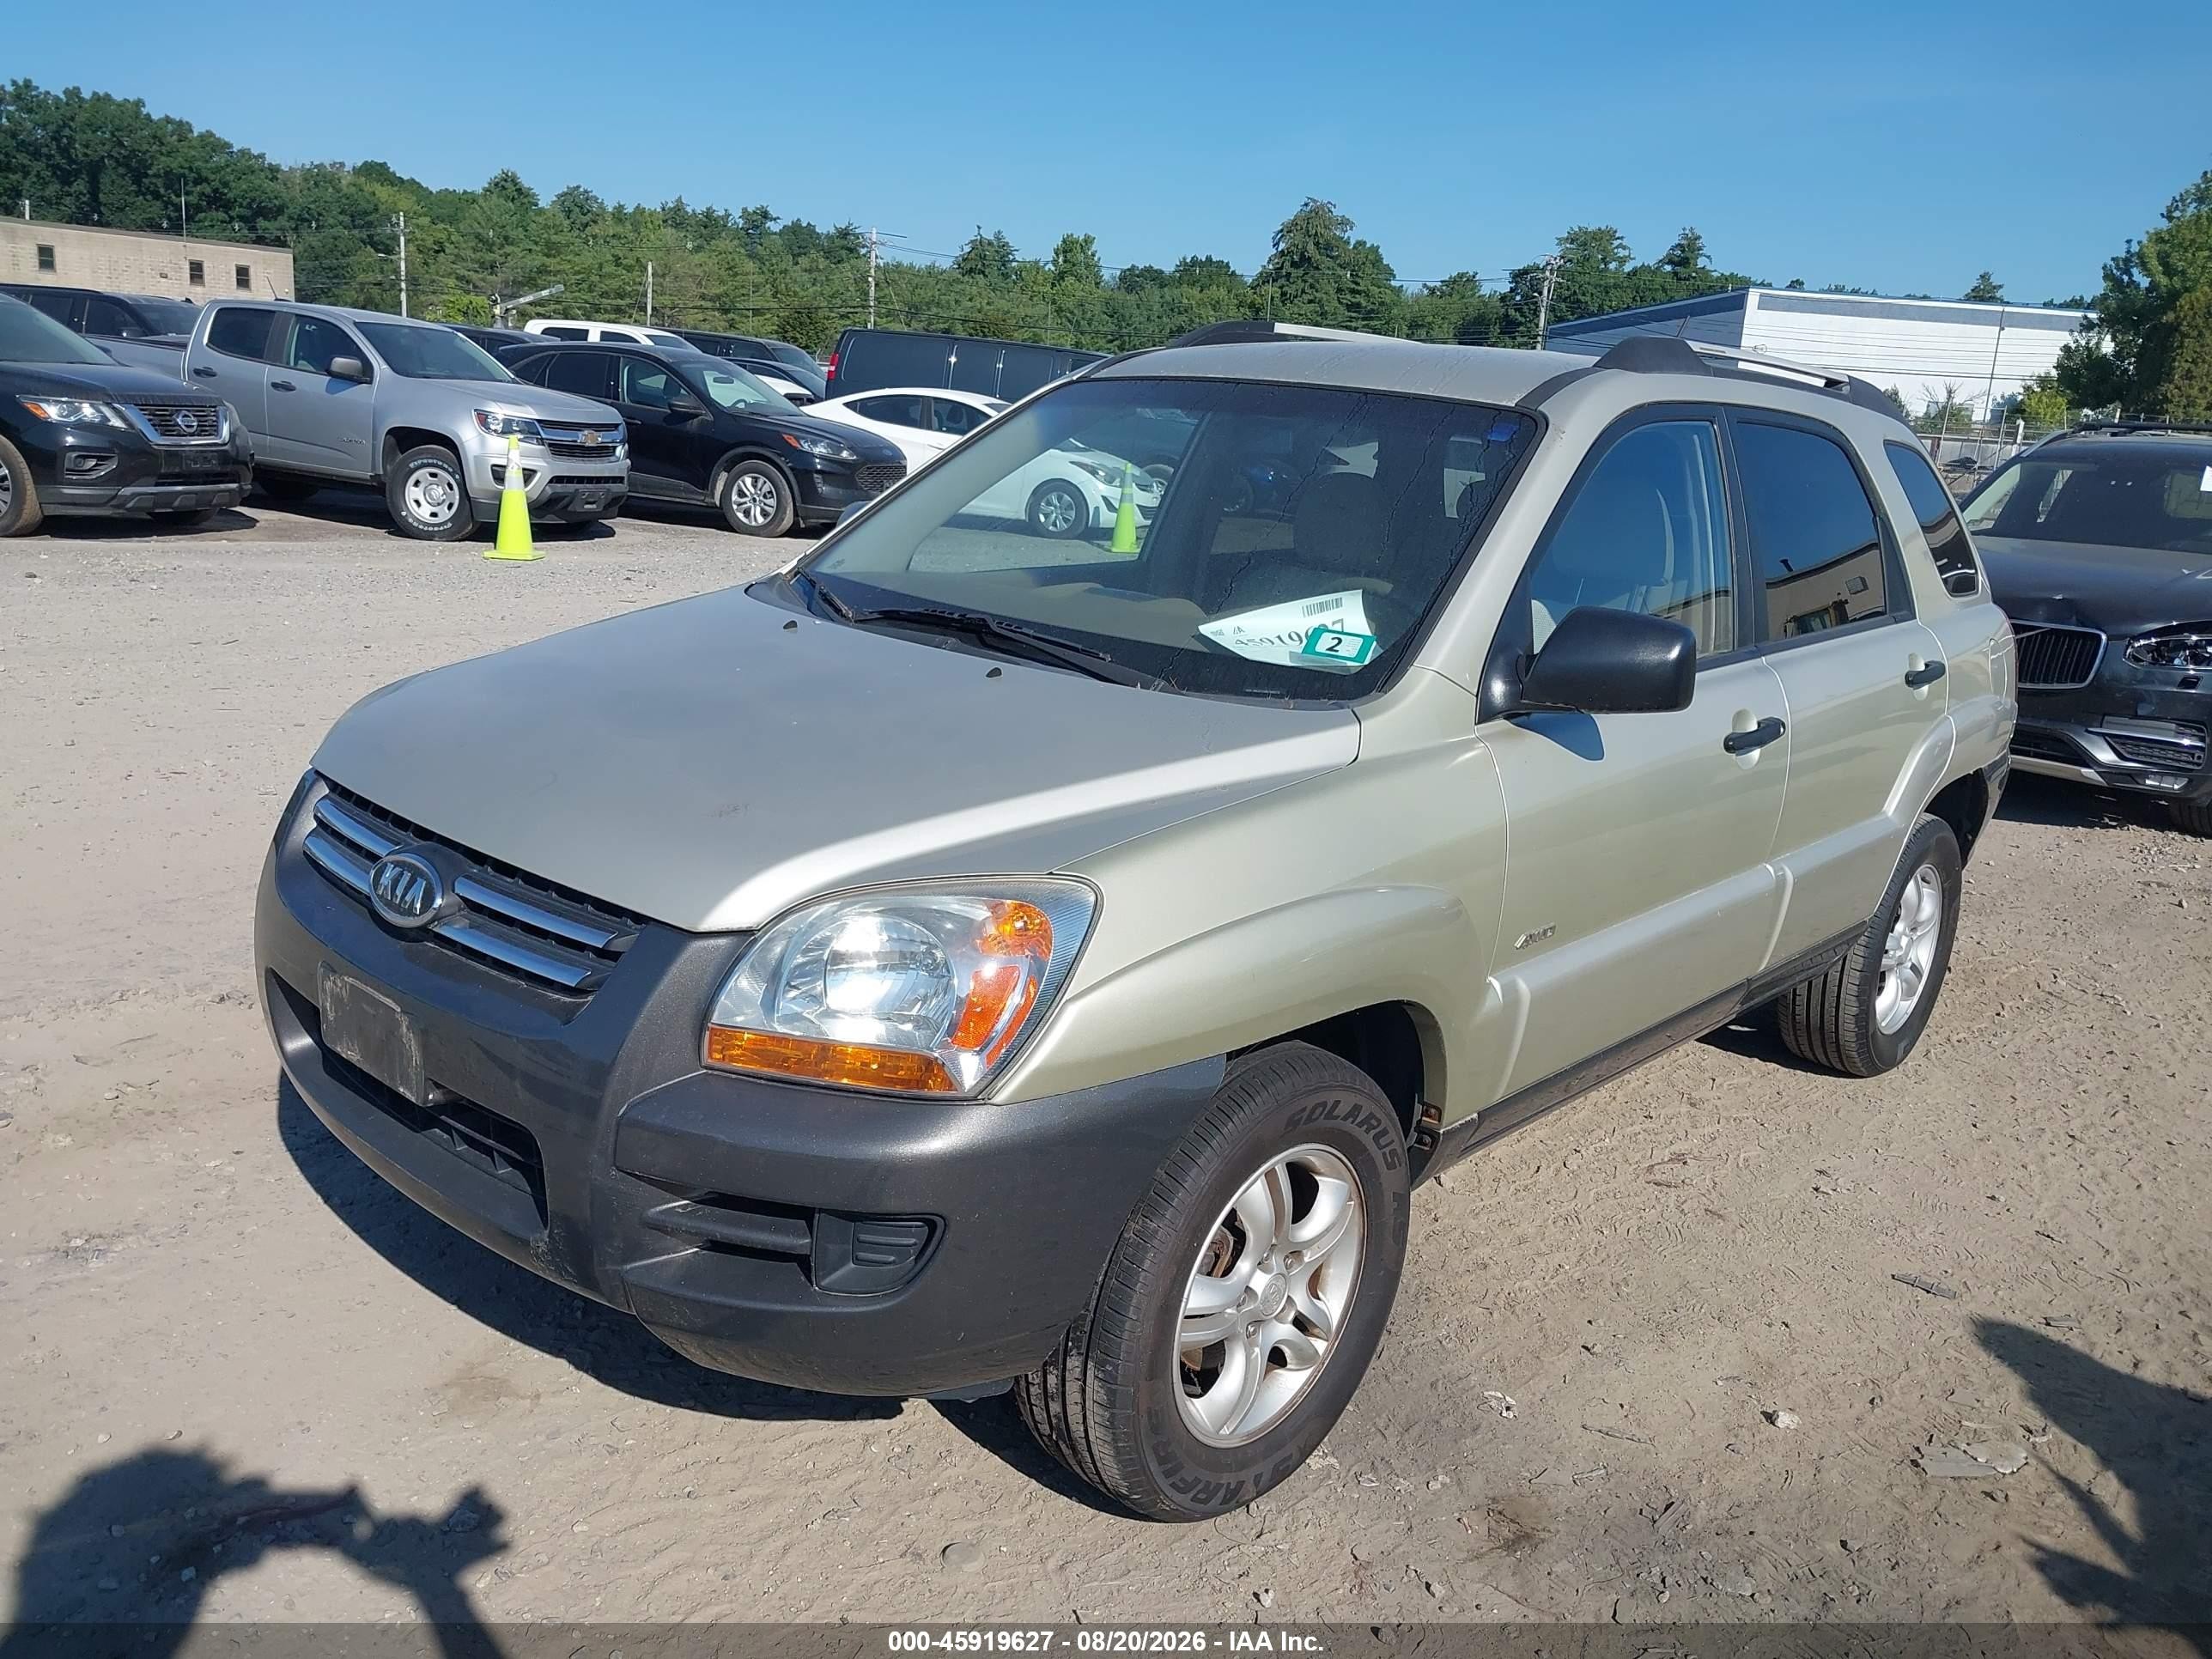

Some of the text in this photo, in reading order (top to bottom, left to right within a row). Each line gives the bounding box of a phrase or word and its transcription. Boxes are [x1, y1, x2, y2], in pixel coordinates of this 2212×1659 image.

[1325, 636, 1342, 653] 2
[376, 862, 427, 915] KIA
[1284, 1099, 1402, 1171] SOLARUS
